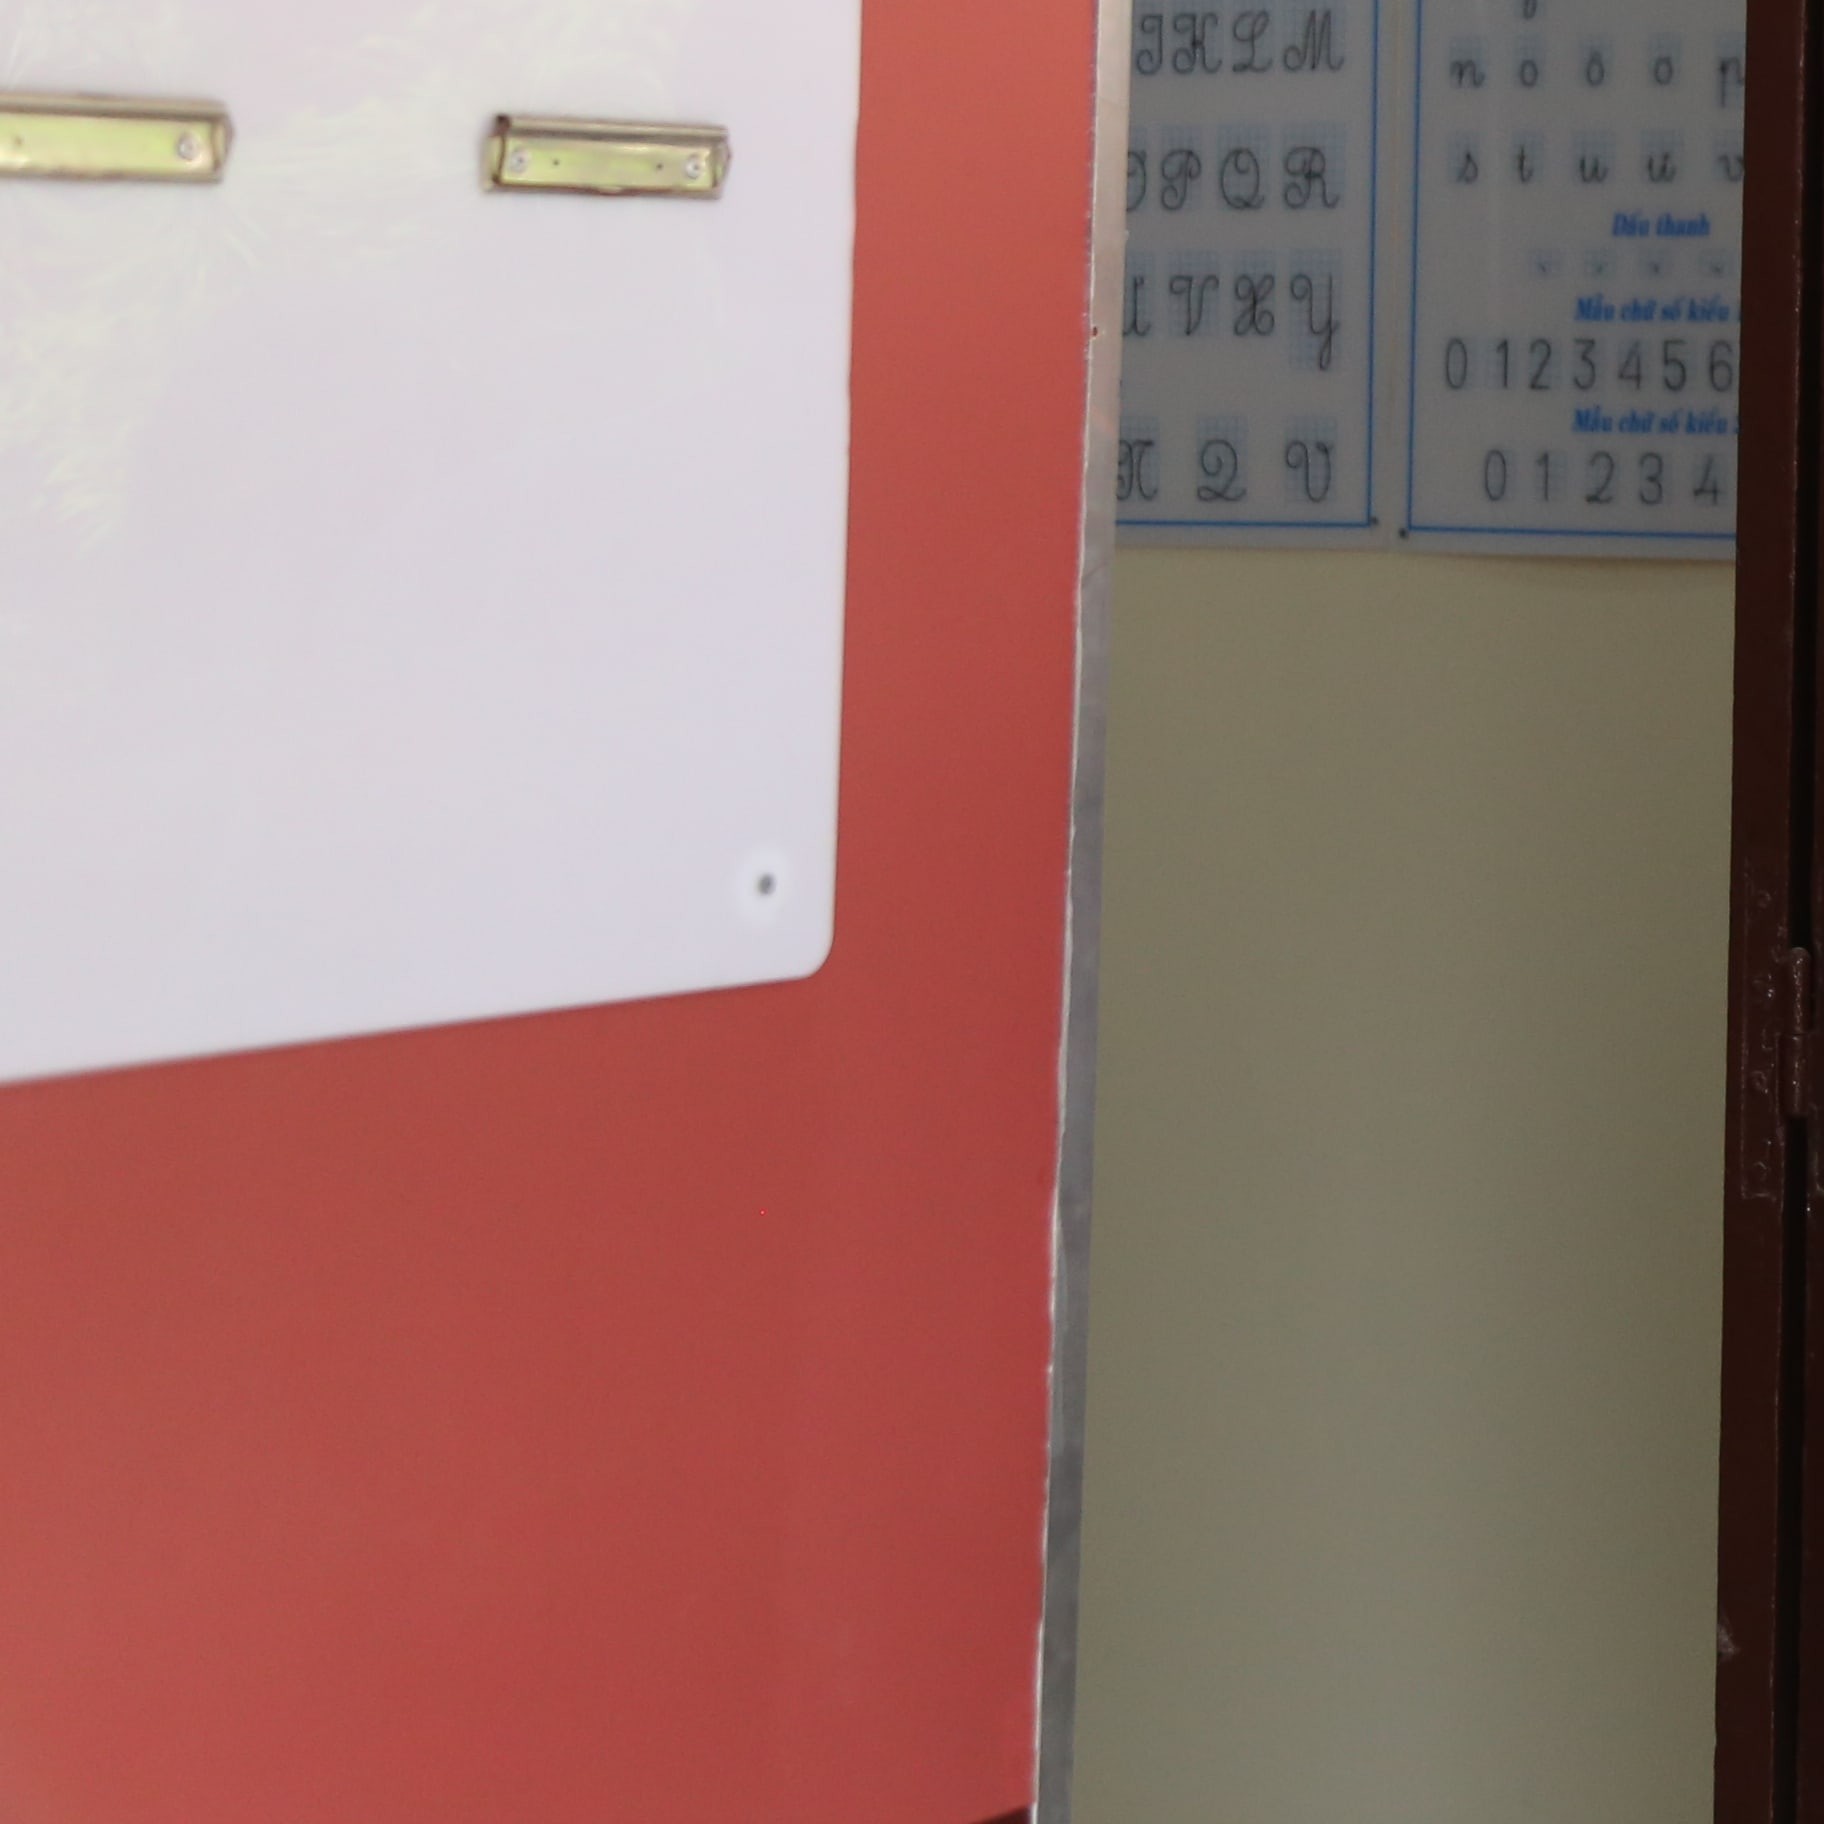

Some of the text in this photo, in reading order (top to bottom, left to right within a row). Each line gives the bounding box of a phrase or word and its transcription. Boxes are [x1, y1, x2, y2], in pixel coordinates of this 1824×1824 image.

[1446, 337, 1734, 392] 0 1 2 3 4 5 6
[1484, 449, 1720, 505] 0 1 2 3 4
